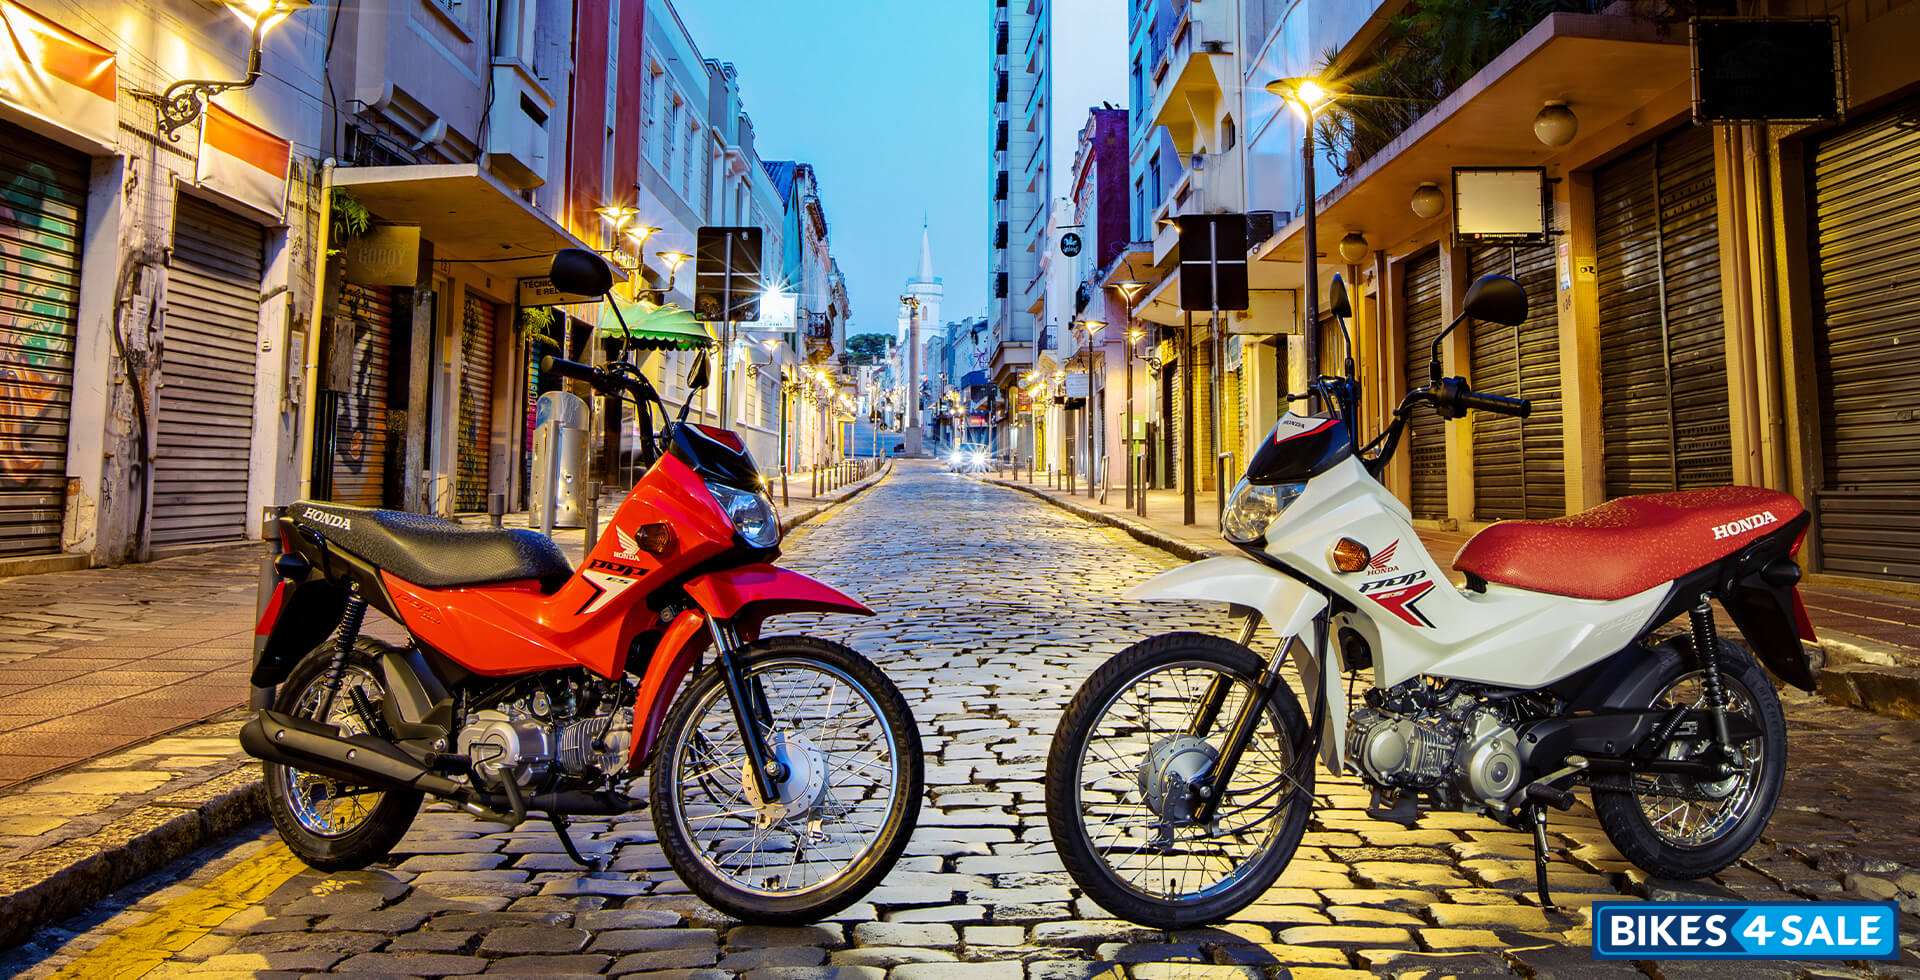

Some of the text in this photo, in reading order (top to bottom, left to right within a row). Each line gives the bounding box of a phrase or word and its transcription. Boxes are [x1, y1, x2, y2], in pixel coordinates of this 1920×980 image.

[1283, 420, 1305, 429] HONDA
[302, 507, 351, 531] HONDA
[1711, 510, 1778, 541] HONDA
[613, 551, 641, 562] HONDA
[1367, 565, 1400, 576] HONDA
